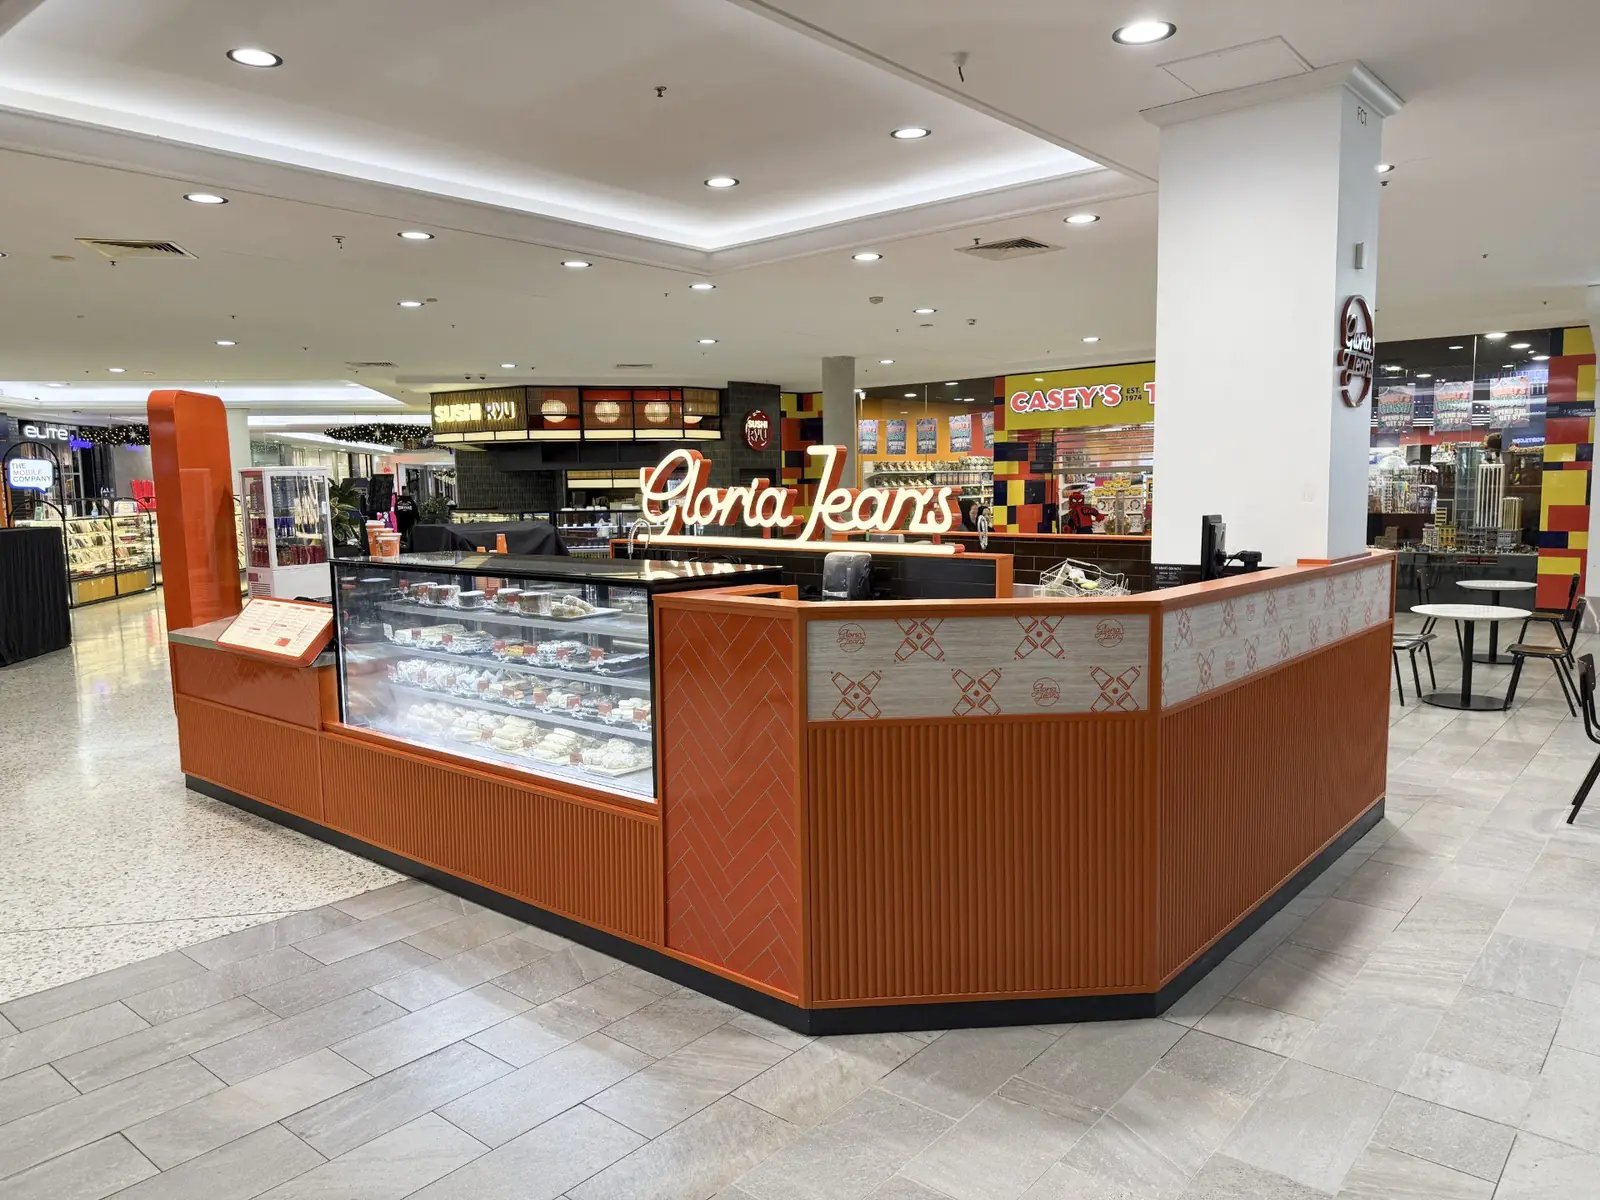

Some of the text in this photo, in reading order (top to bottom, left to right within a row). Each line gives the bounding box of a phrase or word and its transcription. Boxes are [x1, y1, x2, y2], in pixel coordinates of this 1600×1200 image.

[1010, 384, 1122, 413] CASEY'S
[1125, 394, 1142, 402] 1974
[434, 401, 516, 423] SUSHI RYU
[747, 420, 769, 429] SUSHI
[13, 475, 52, 483] COMPANY
[640, 445, 953, 541] Gloria Jeans
